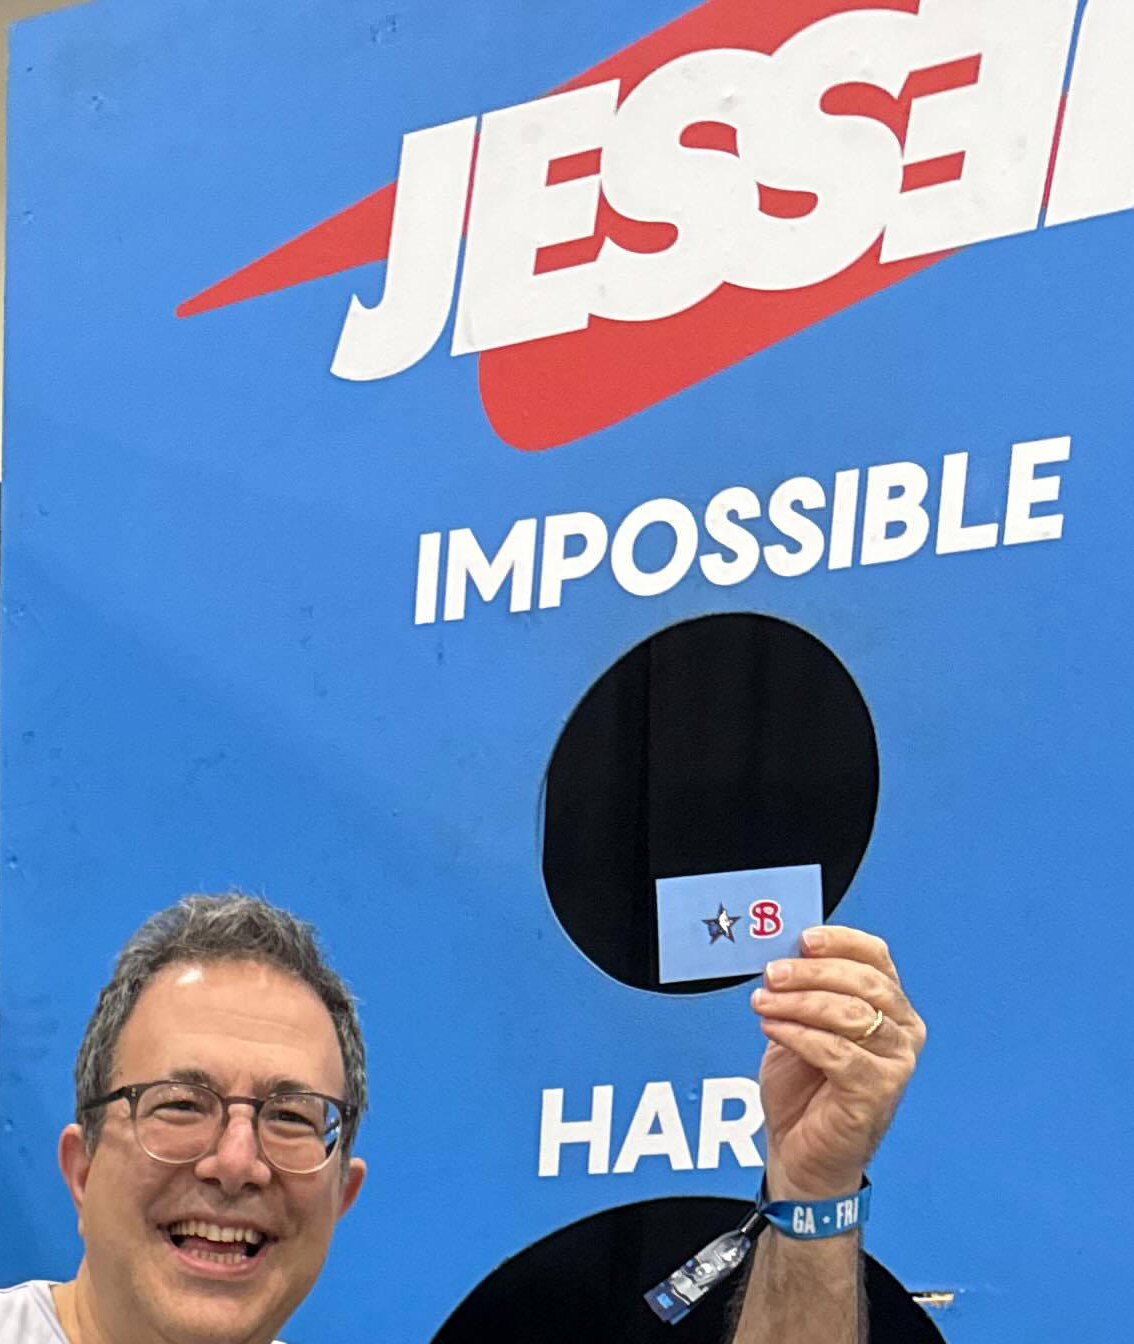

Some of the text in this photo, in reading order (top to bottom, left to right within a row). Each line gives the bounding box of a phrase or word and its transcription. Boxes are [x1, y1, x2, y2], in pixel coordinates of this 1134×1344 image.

[414, 435, 1072, 626] IMPOSSIBLE
[749, 899, 784, 939] B
[538, 1075, 766, 1178] HAR
[792, 1205, 816, 1235] GA
